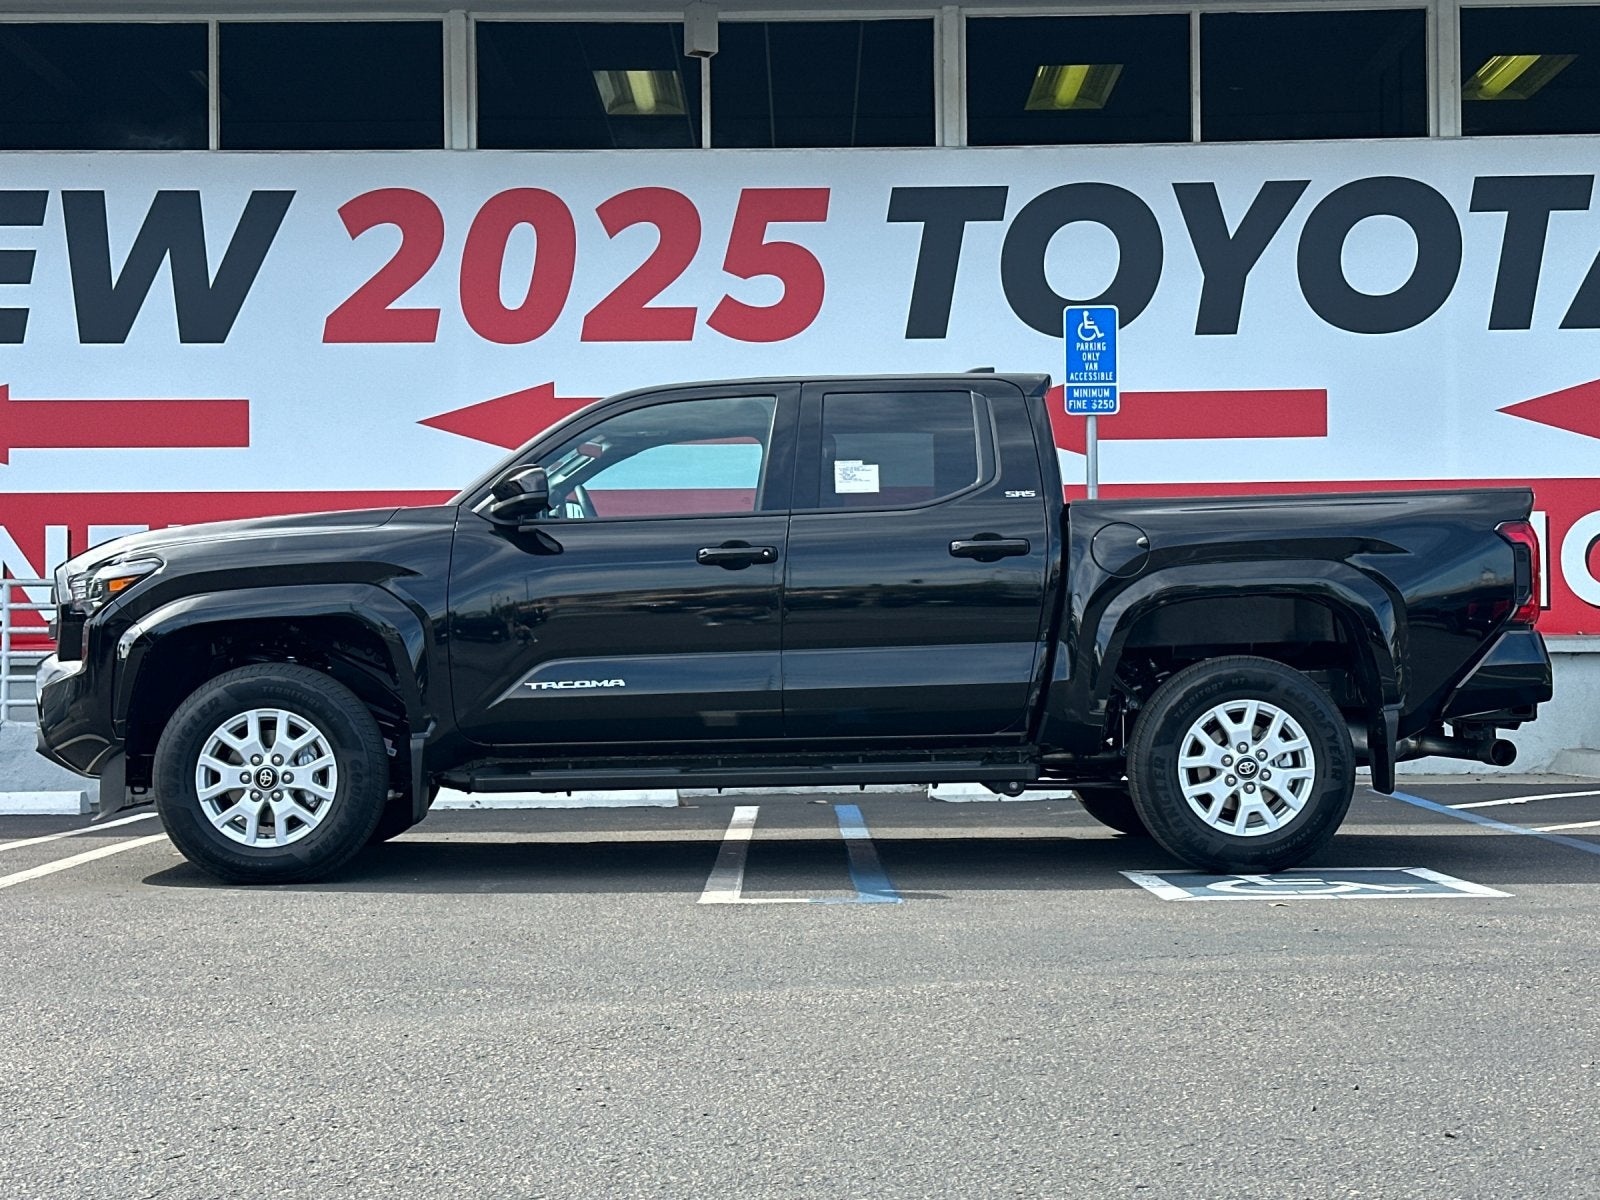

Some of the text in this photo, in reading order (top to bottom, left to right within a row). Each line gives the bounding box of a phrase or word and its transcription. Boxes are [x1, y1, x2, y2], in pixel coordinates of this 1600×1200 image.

[324, 188, 828, 343] 2025
[887, 175, 1600, 338] TOYOT
[1076, 342, 1106, 351] PARKING
[1082, 352, 1100, 361] ONLY
[1085, 362, 1098, 371] VAN
[1070, 372, 1113, 381] ACCESSIBLE
[1073, 388, 1110, 398] MINIMUM
[1069, 400, 1114, 410] FINE $250
[524, 679, 625, 690] TACOMA
